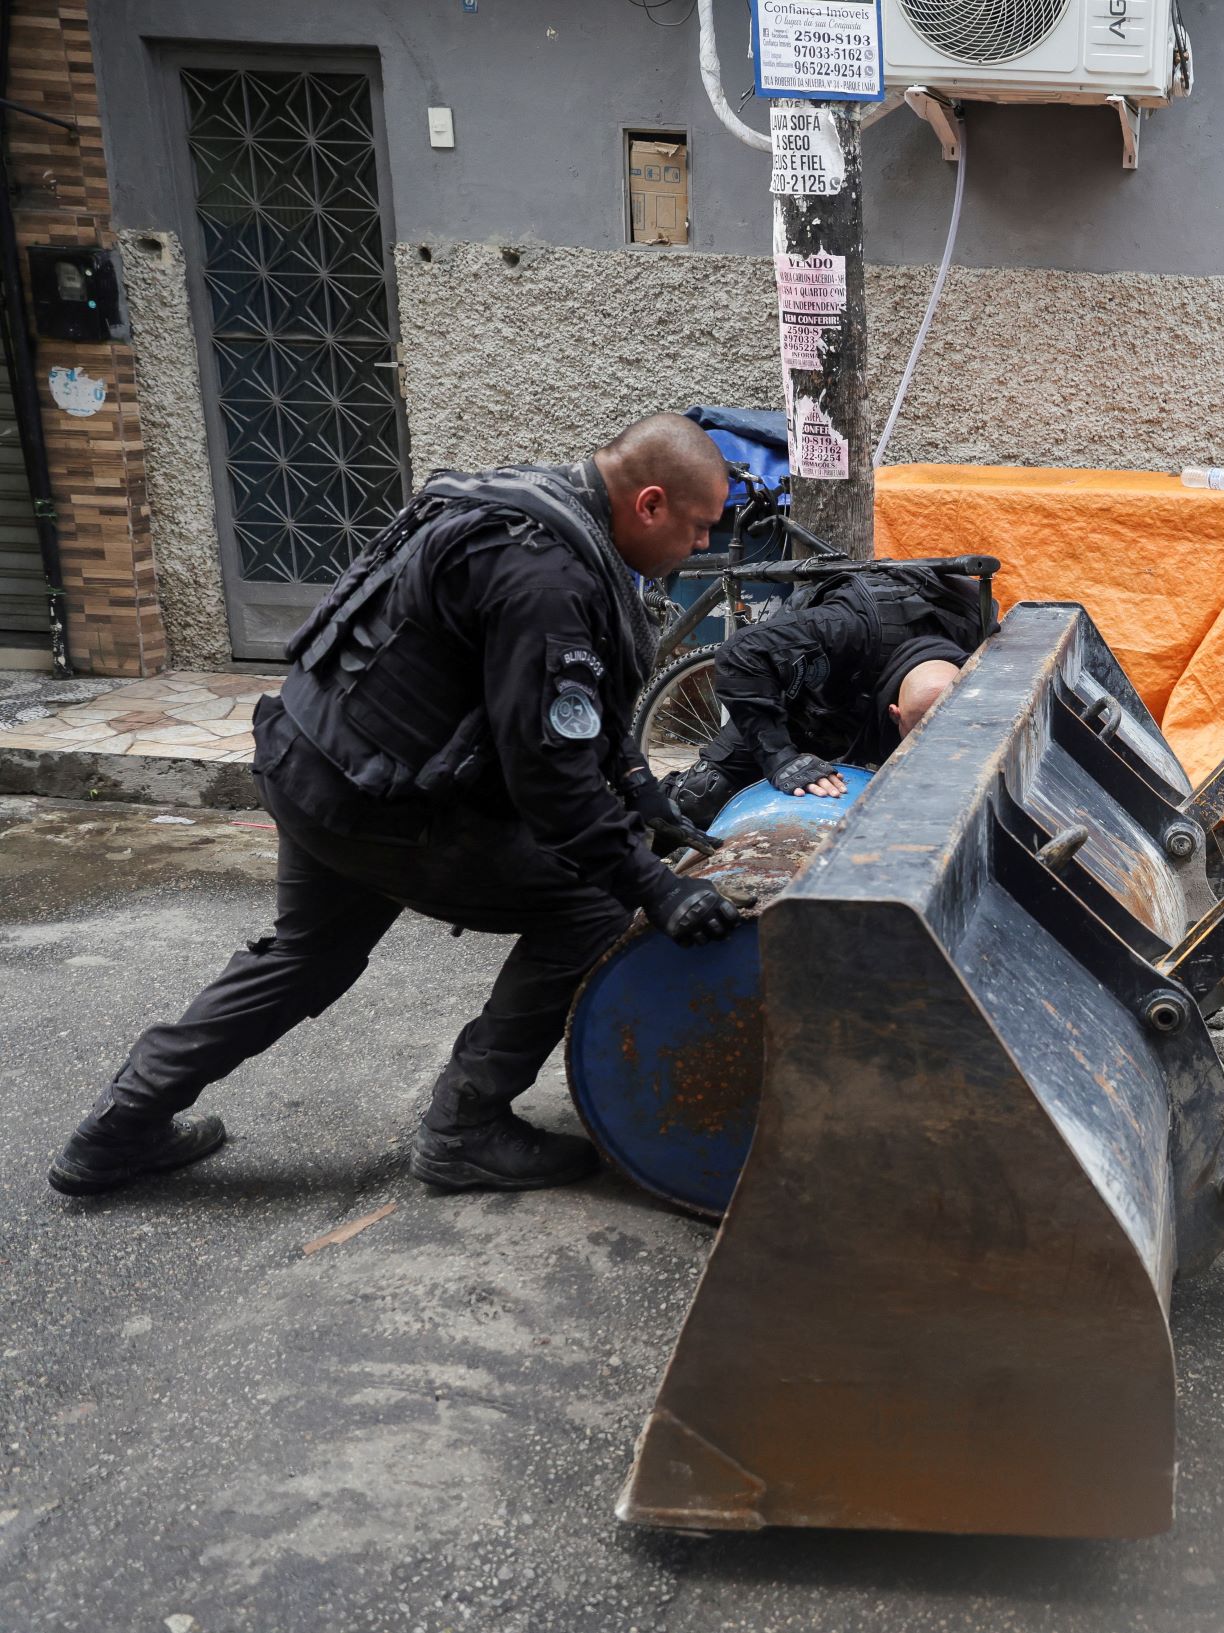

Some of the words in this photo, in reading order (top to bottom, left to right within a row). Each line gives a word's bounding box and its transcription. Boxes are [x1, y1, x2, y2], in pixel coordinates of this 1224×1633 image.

[764, 1, 822, 17] Confiança
[827, 6, 870, 20] Imóveis
[794, 29, 871, 46] 2590-8193
[794, 44, 862, 61] 97033-5162
[794, 60, 862, 78] 96522-9254
[774, 76, 796, 87] ROBERTO
[797, 78, 804, 87] DA
[843, 80, 861, 91] PARQUE
[790, 112, 821, 131] SOFÁ
[782, 134, 810, 151] SECO
[790, 151, 797, 171] É
[800, 154, 826, 171] FIEL
[788, 257, 833, 269] VENDO
[811, 273, 835, 284] LACERDA
[800, 287, 828, 298] QUARTO
[784, 313, 797, 323] VEM
[798, 315, 840, 324] CONFERIR!
[787, 326, 819, 336] 2590-8
[802, 452, 841, 462] 22-9254
[563, 650, 606, 677] BLINDADOS
